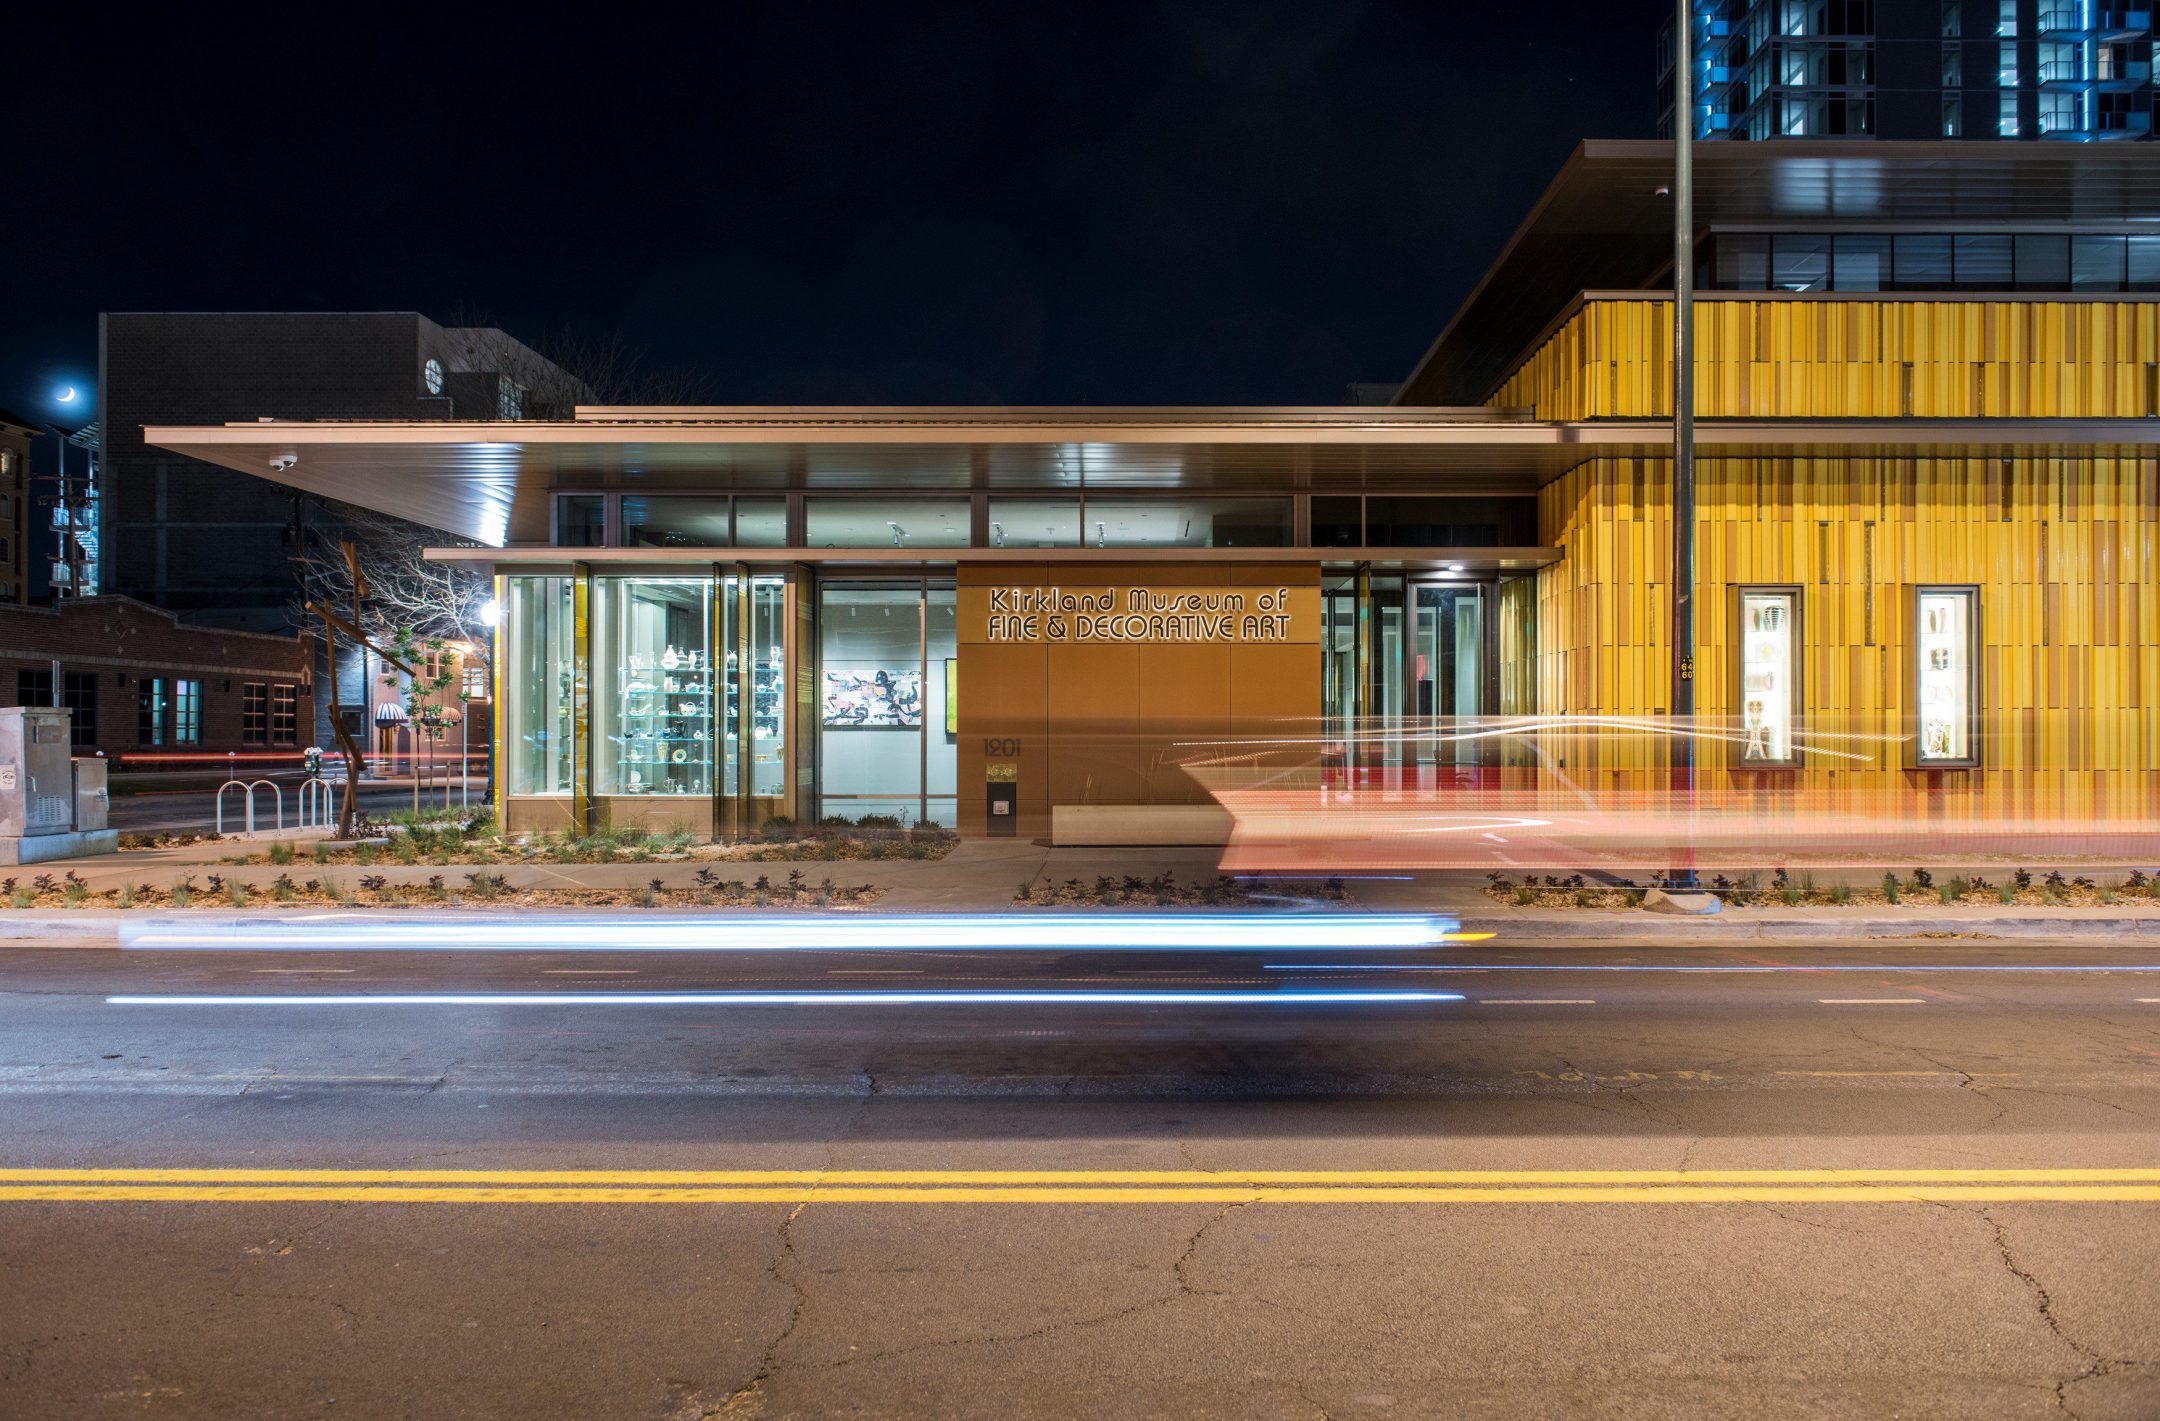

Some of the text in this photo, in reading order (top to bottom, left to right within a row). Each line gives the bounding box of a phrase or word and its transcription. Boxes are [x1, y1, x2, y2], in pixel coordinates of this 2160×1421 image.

[991, 588, 1287, 610] Kirkland Museum of
[989, 615, 1290, 638] FINE & DECORATIVE ART
[1681, 663, 1693, 671] 64
[1681, 671, 1693, 679] 60
[984, 737, 1022, 757] 1201
